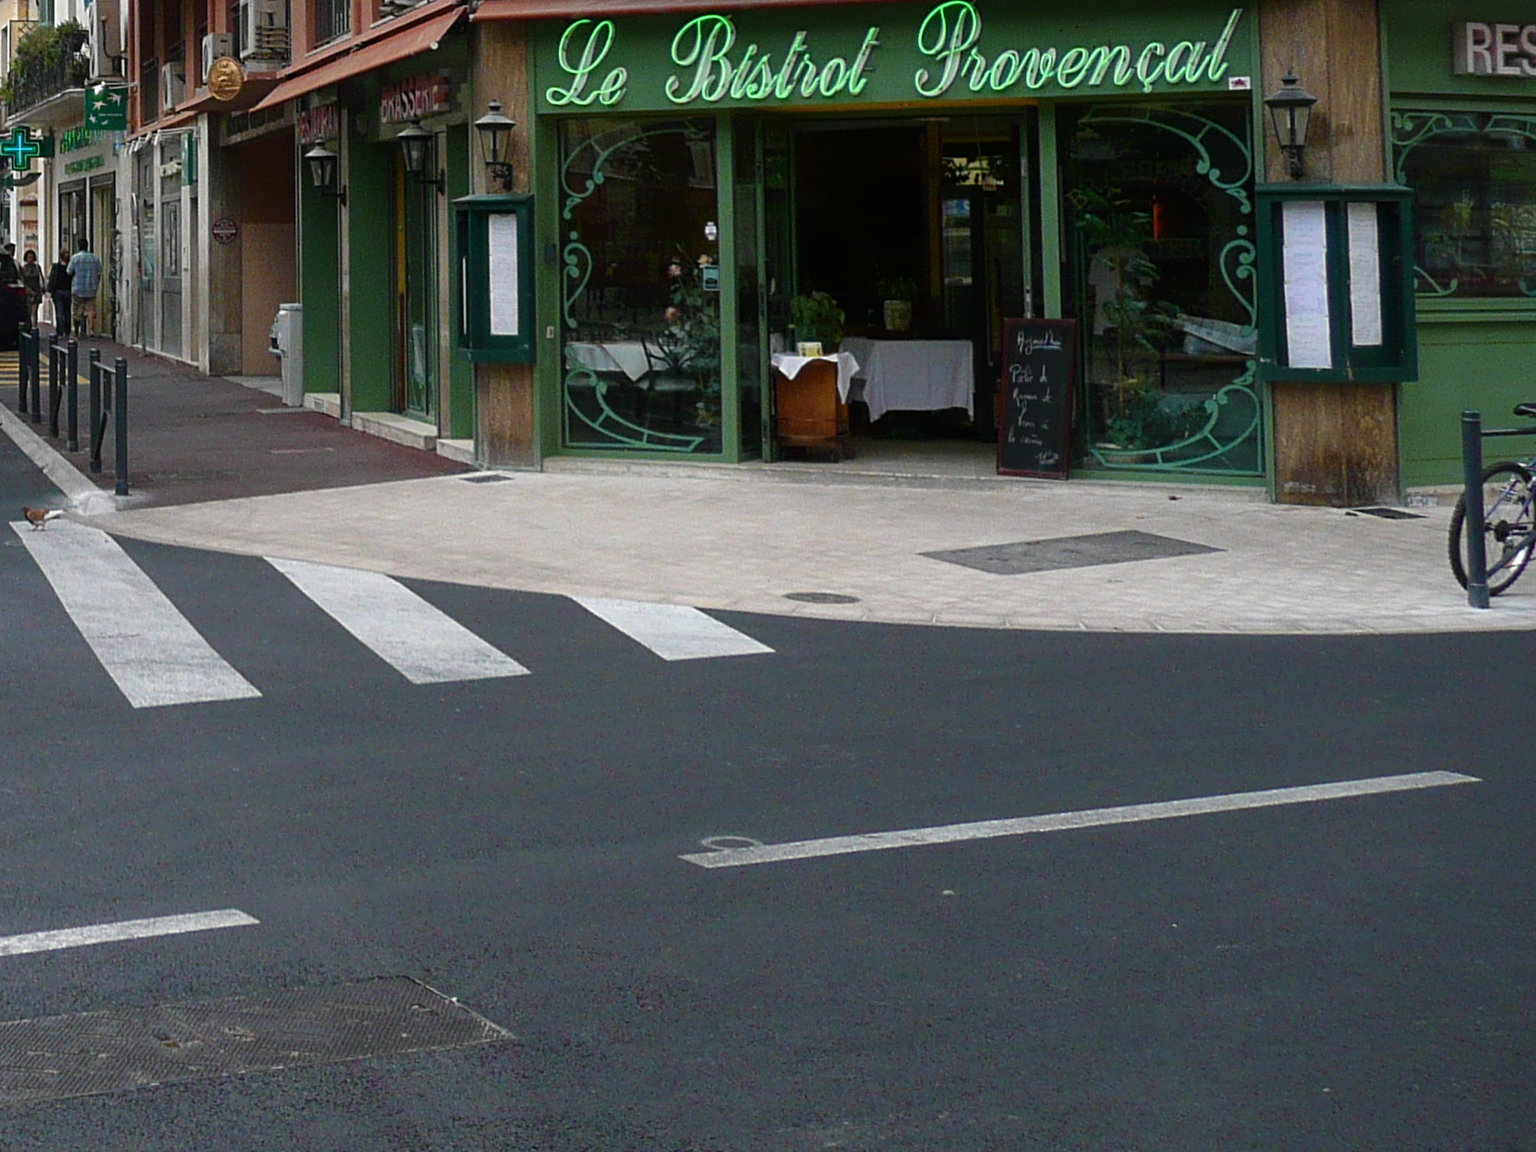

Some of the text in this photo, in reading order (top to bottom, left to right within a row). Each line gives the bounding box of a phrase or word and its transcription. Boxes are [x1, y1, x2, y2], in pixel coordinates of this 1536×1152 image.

[546, 0, 1243, 105] Le Bistrot Provençal
